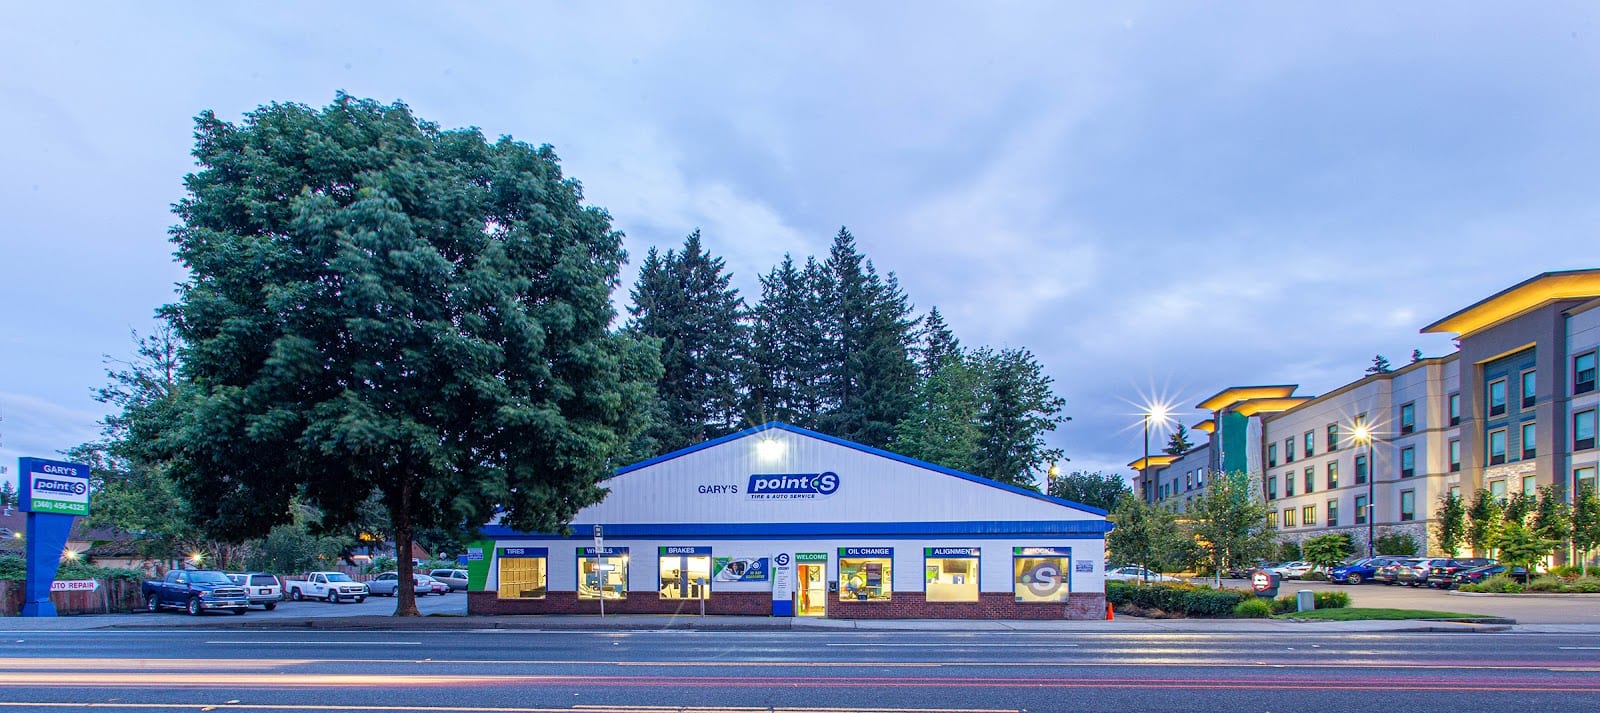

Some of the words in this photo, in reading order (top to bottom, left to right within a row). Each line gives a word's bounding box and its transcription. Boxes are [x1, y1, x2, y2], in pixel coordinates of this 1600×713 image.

[43, 464, 78, 476] GARY'S
[37, 480, 69, 491] point
[698, 485, 738, 493] GARY'S
[754, 476, 809, 491] point
